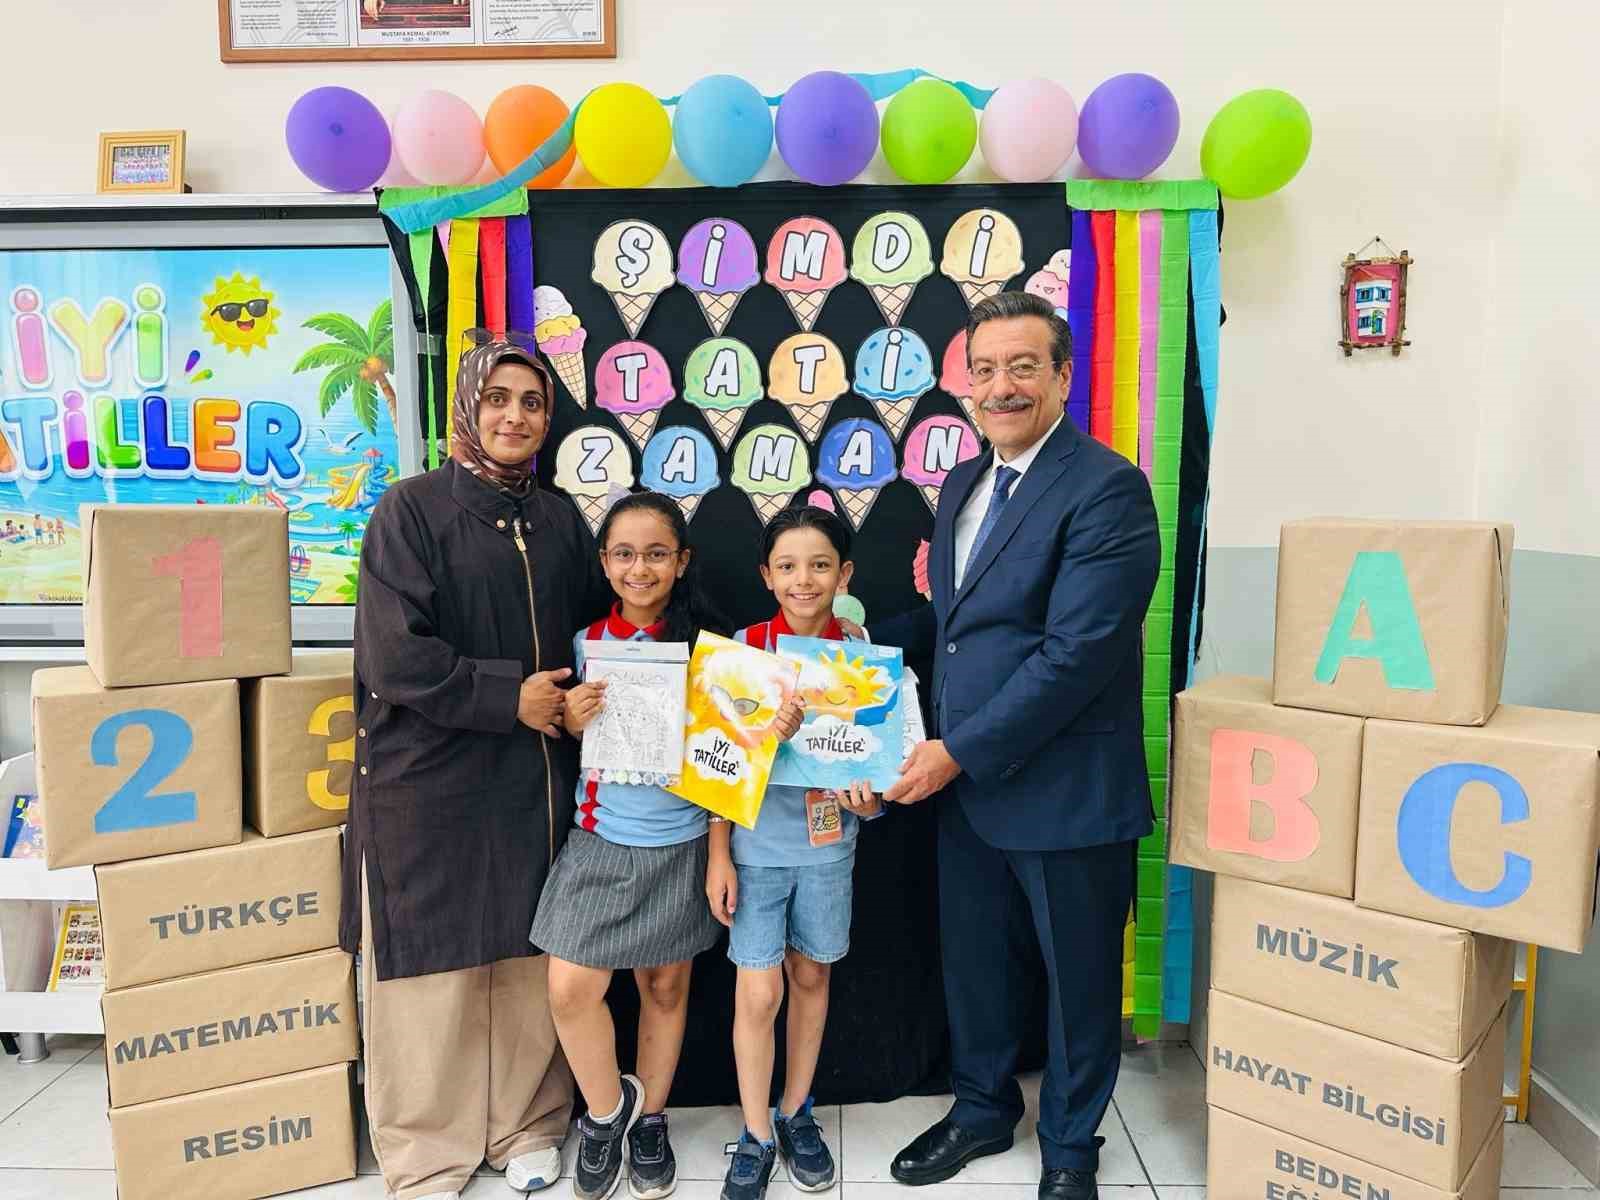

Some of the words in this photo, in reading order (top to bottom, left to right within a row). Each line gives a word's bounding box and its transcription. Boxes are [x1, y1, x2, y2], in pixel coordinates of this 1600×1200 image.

[615, 214, 996, 287] ŞİMDİ
[615, 329, 903, 401] TATİ
[577, 425, 963, 483] ZAMAN
[150, 536, 223, 657] 1
[1313, 551, 1437, 690] A
[90, 708, 198, 834] 2
[1207, 728, 1320, 862] B
[1396, 762, 1533, 909] C
[150, 891, 319, 939] TÜRKÇE
[1256, 924, 1399, 989] MÜZİK
[114, 1000, 340, 1065] MATEMATİK
[1213, 1046, 1312, 1095] HAYAT
[1322, 1083, 1448, 1146] BİLGİSİ
[183, 1115, 312, 1162] RESİM
[1275, 1150, 1390, 1200] BEDEN
